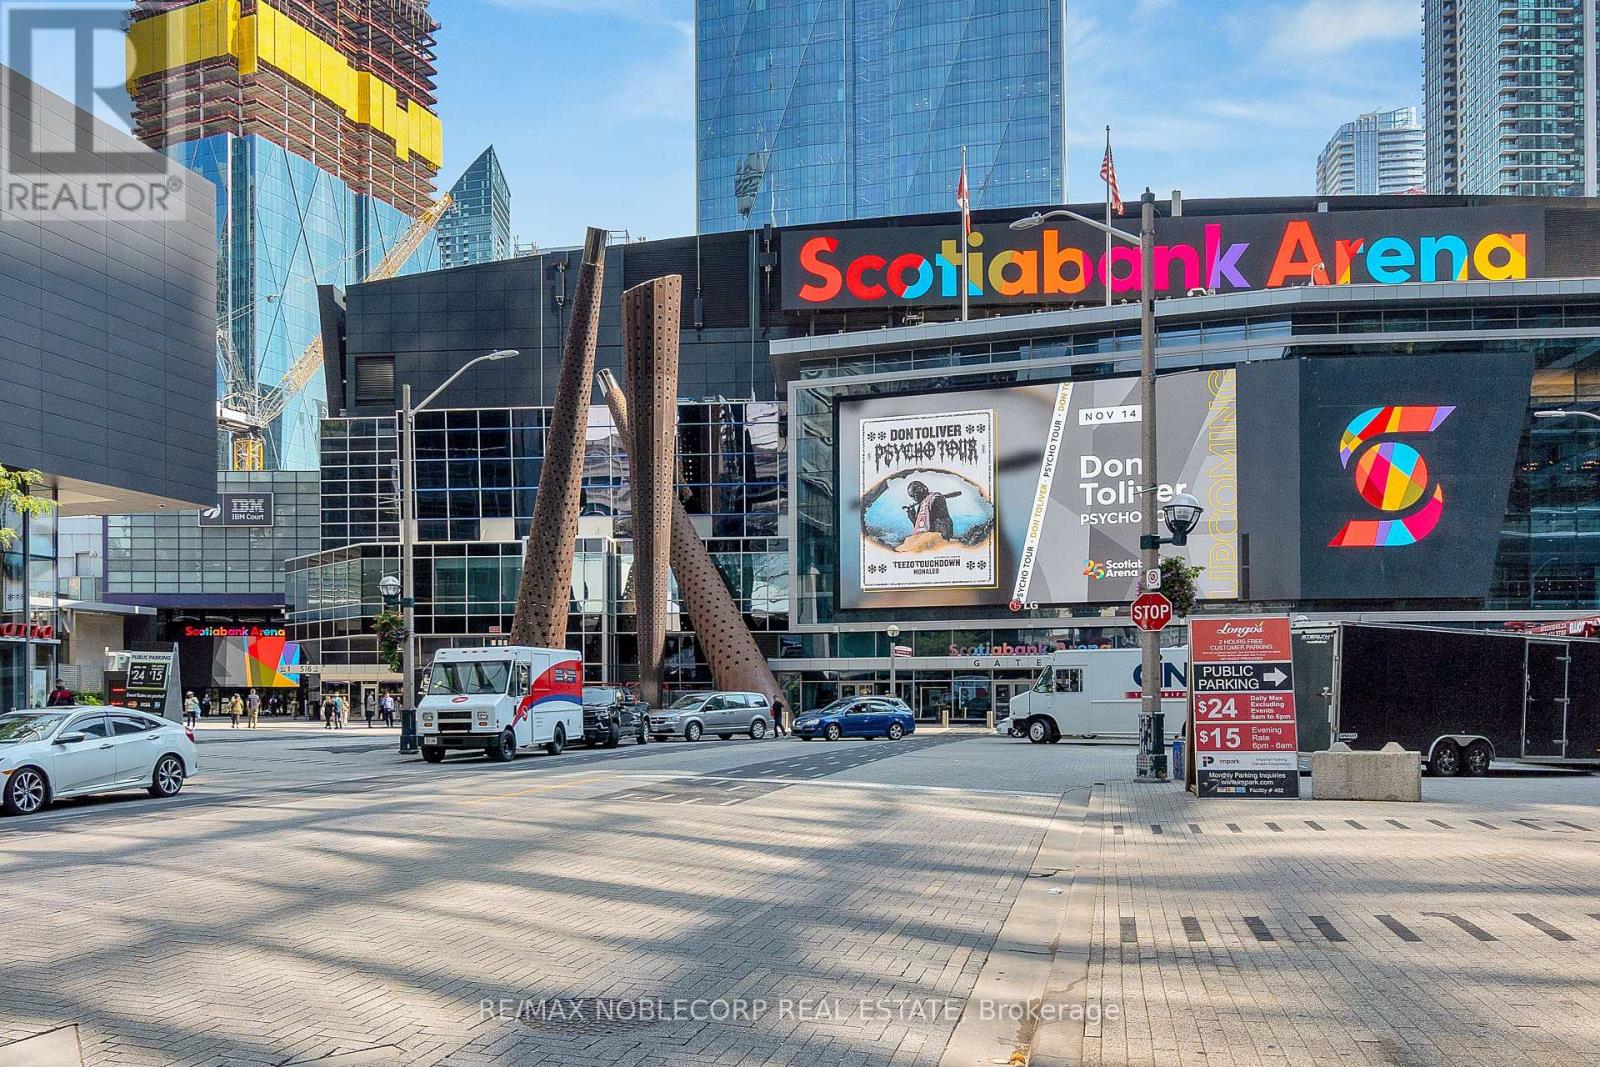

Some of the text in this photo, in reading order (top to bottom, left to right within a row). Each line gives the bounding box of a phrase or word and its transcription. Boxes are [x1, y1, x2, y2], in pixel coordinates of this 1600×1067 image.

[799, 220, 1527, 302] Scotiabank Arena
[1058, 392, 1068, 412] DON
[1085, 410, 1136, 421] NOV 14
[890, 424, 962, 441] DON TOLIVER
[1051, 420, 1062, 442] TOUR
[875, 437, 978, 474] PSYCHO TOUR
[1043, 444, 1057, 478] PSYCHO
[1080, 455, 1142, 479] Don
[1208, 369, 1237, 599] UPCOMING
[231, 498, 264, 513] IBM
[1034, 484, 1048, 518] TOLIVER
[1080, 510, 1142, 526] PSYCHO
[1030, 519, 1040, 539] DON
[892, 559, 961, 569] TEEZO TOUCHDOWN
[1023, 546, 1034, 568] TOUR
[1106, 569, 1138, 577] Arena
[1023, 602, 1039, 610] LG
[1134, 604, 1169, 620] STOP
[185, 626, 285, 636] Scotiabank Arena
[949, 641, 1048, 656] Scotiabank
[973, 659, 1042, 667] GATE
[1203, 665, 1254, 677] PUBLIC
[1198, 678, 1260, 690] PARKING
[1198, 697, 1238, 718] $24
[1199, 727, 1241, 748] $15
[1251, 727, 1282, 735] Evening
[1252, 742, 1269, 750] 6pm
